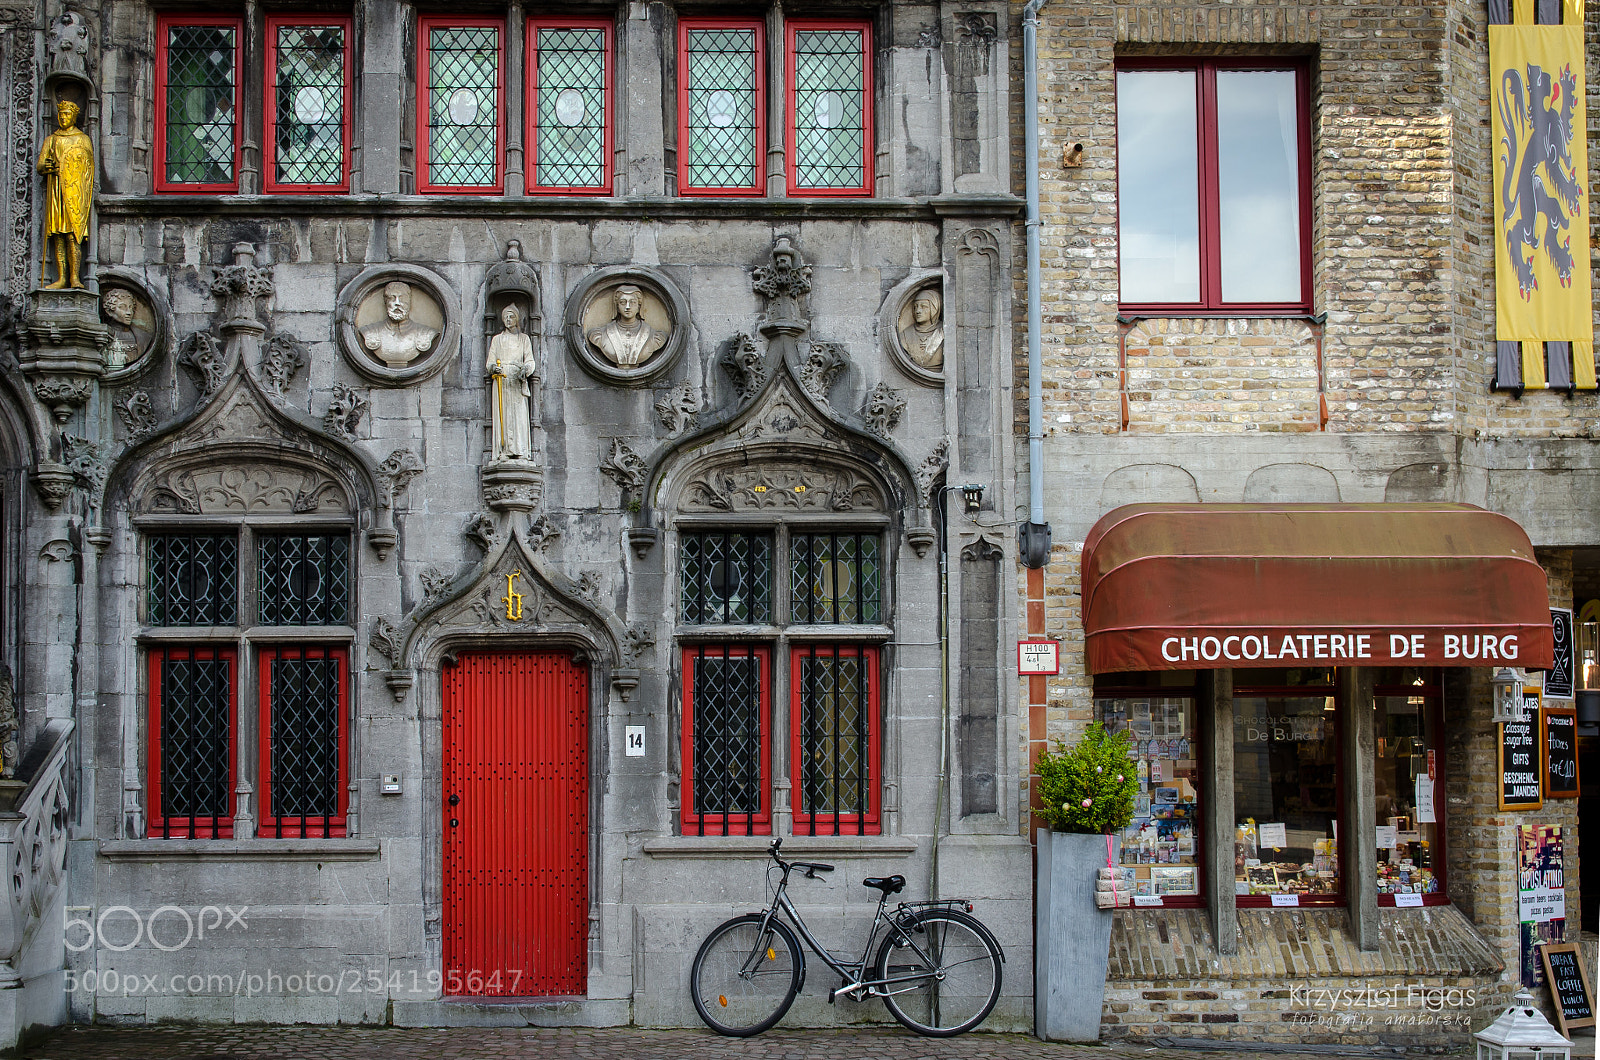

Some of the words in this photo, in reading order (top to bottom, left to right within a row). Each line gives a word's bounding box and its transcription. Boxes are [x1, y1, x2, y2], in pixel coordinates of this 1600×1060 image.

[1160, 634, 1372, 662] CHOCOLATERIE
[1389, 634, 1426, 659] DE
[1444, 635, 1519, 660] BURG
[628, 733, 643, 748] 14
[1512, 753, 1529, 765] GIFTS
[1557, 979, 1584, 992] COFFEE
[1562, 995, 1584, 1005] LUNCH
